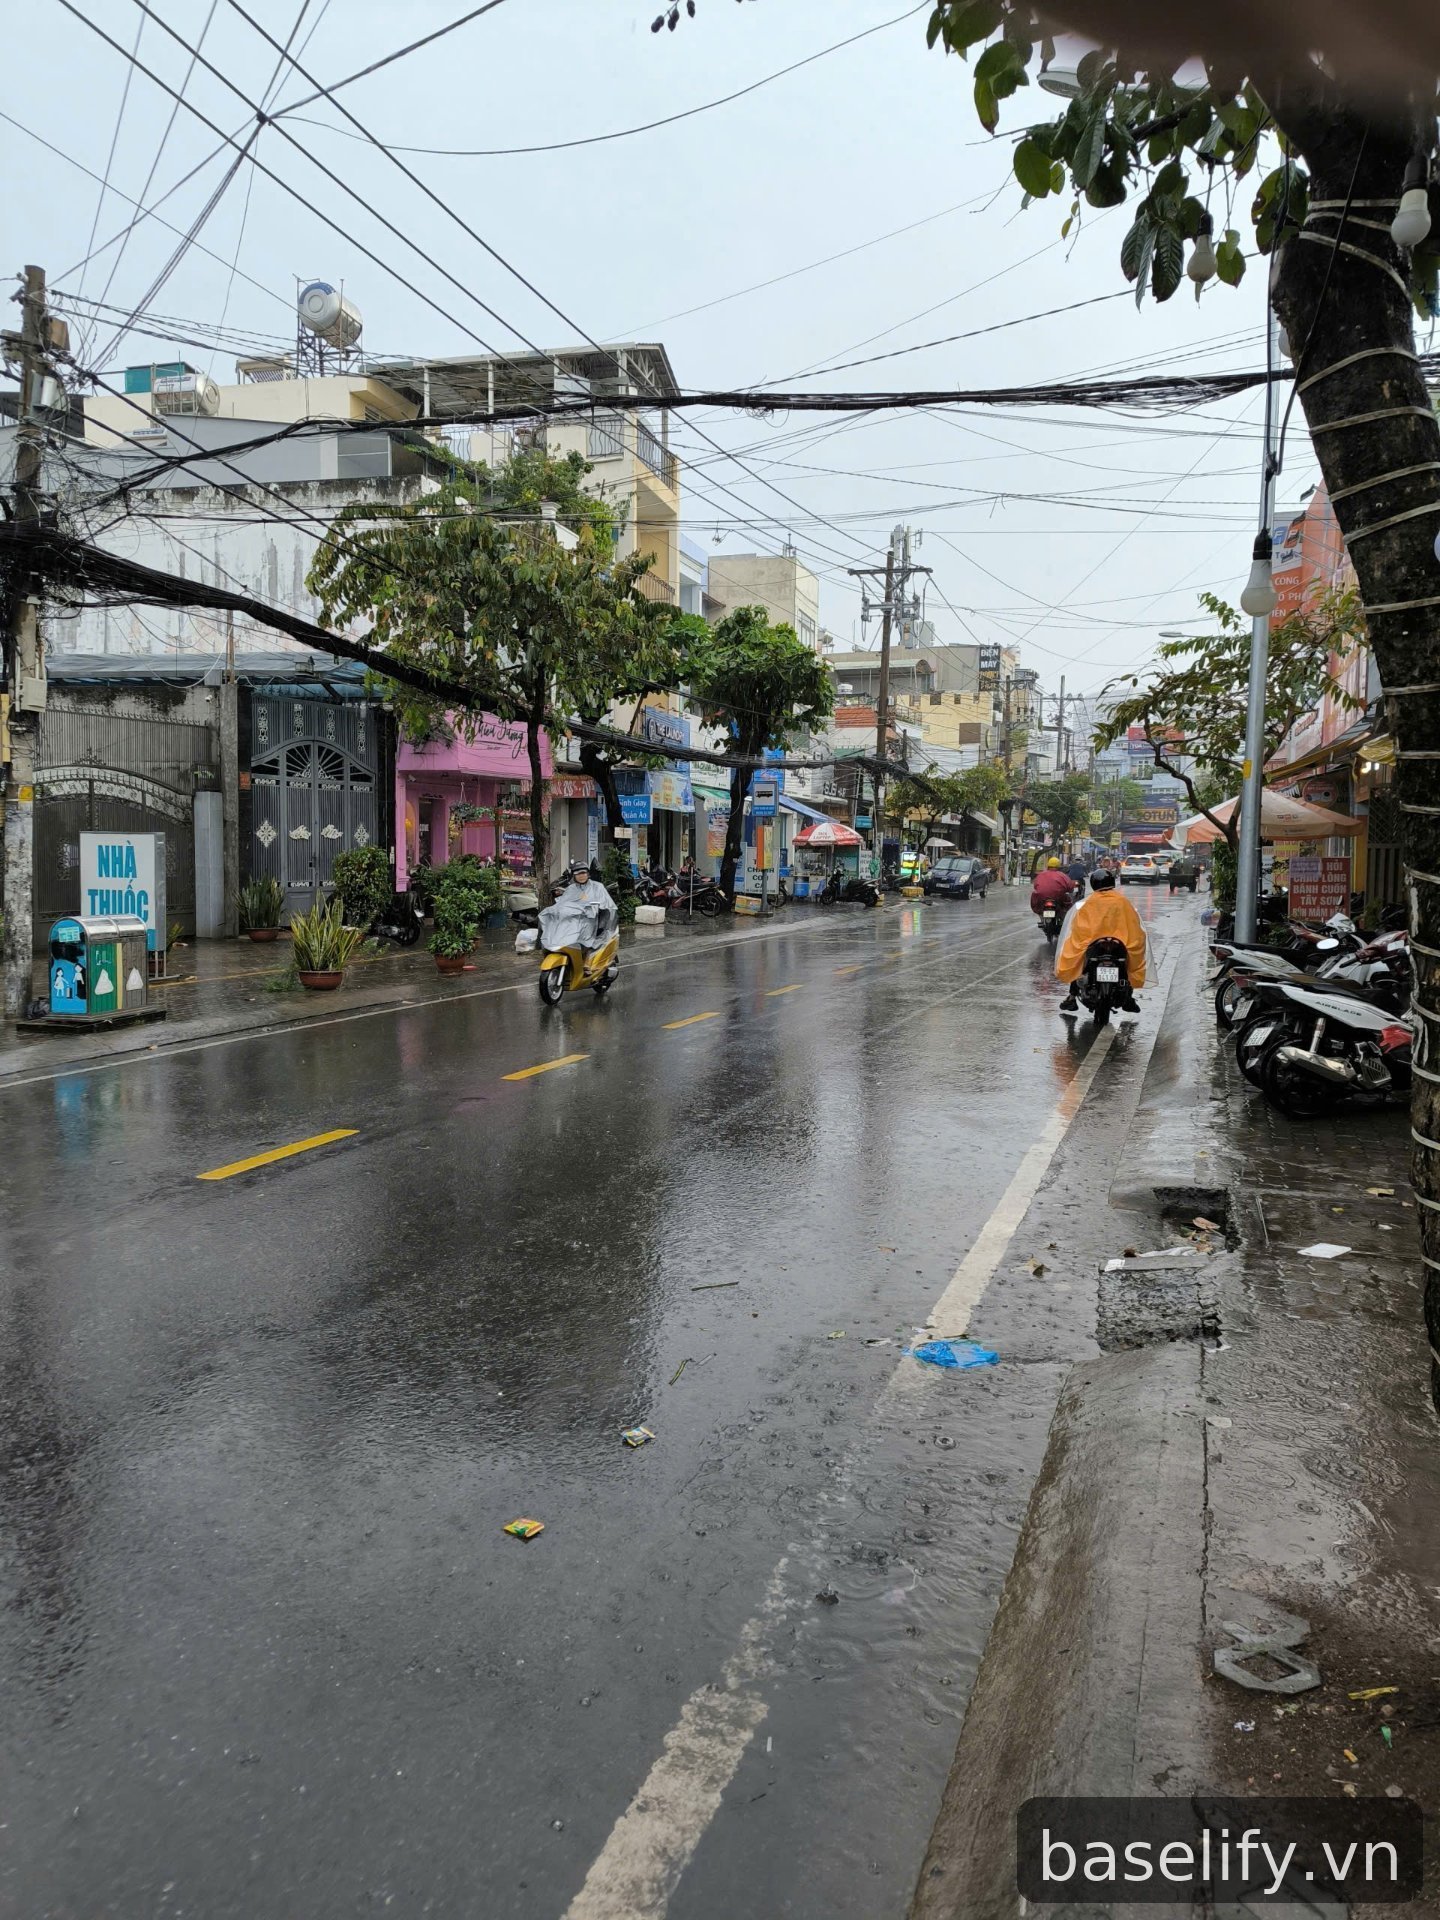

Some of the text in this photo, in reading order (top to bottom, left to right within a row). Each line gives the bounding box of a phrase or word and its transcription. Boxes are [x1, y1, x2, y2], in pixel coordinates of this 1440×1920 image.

[97, 840, 138, 879] NHÀ
[87, 879, 149, 924] THUỐC
[1293, 883, 1319, 894] BÁNH
